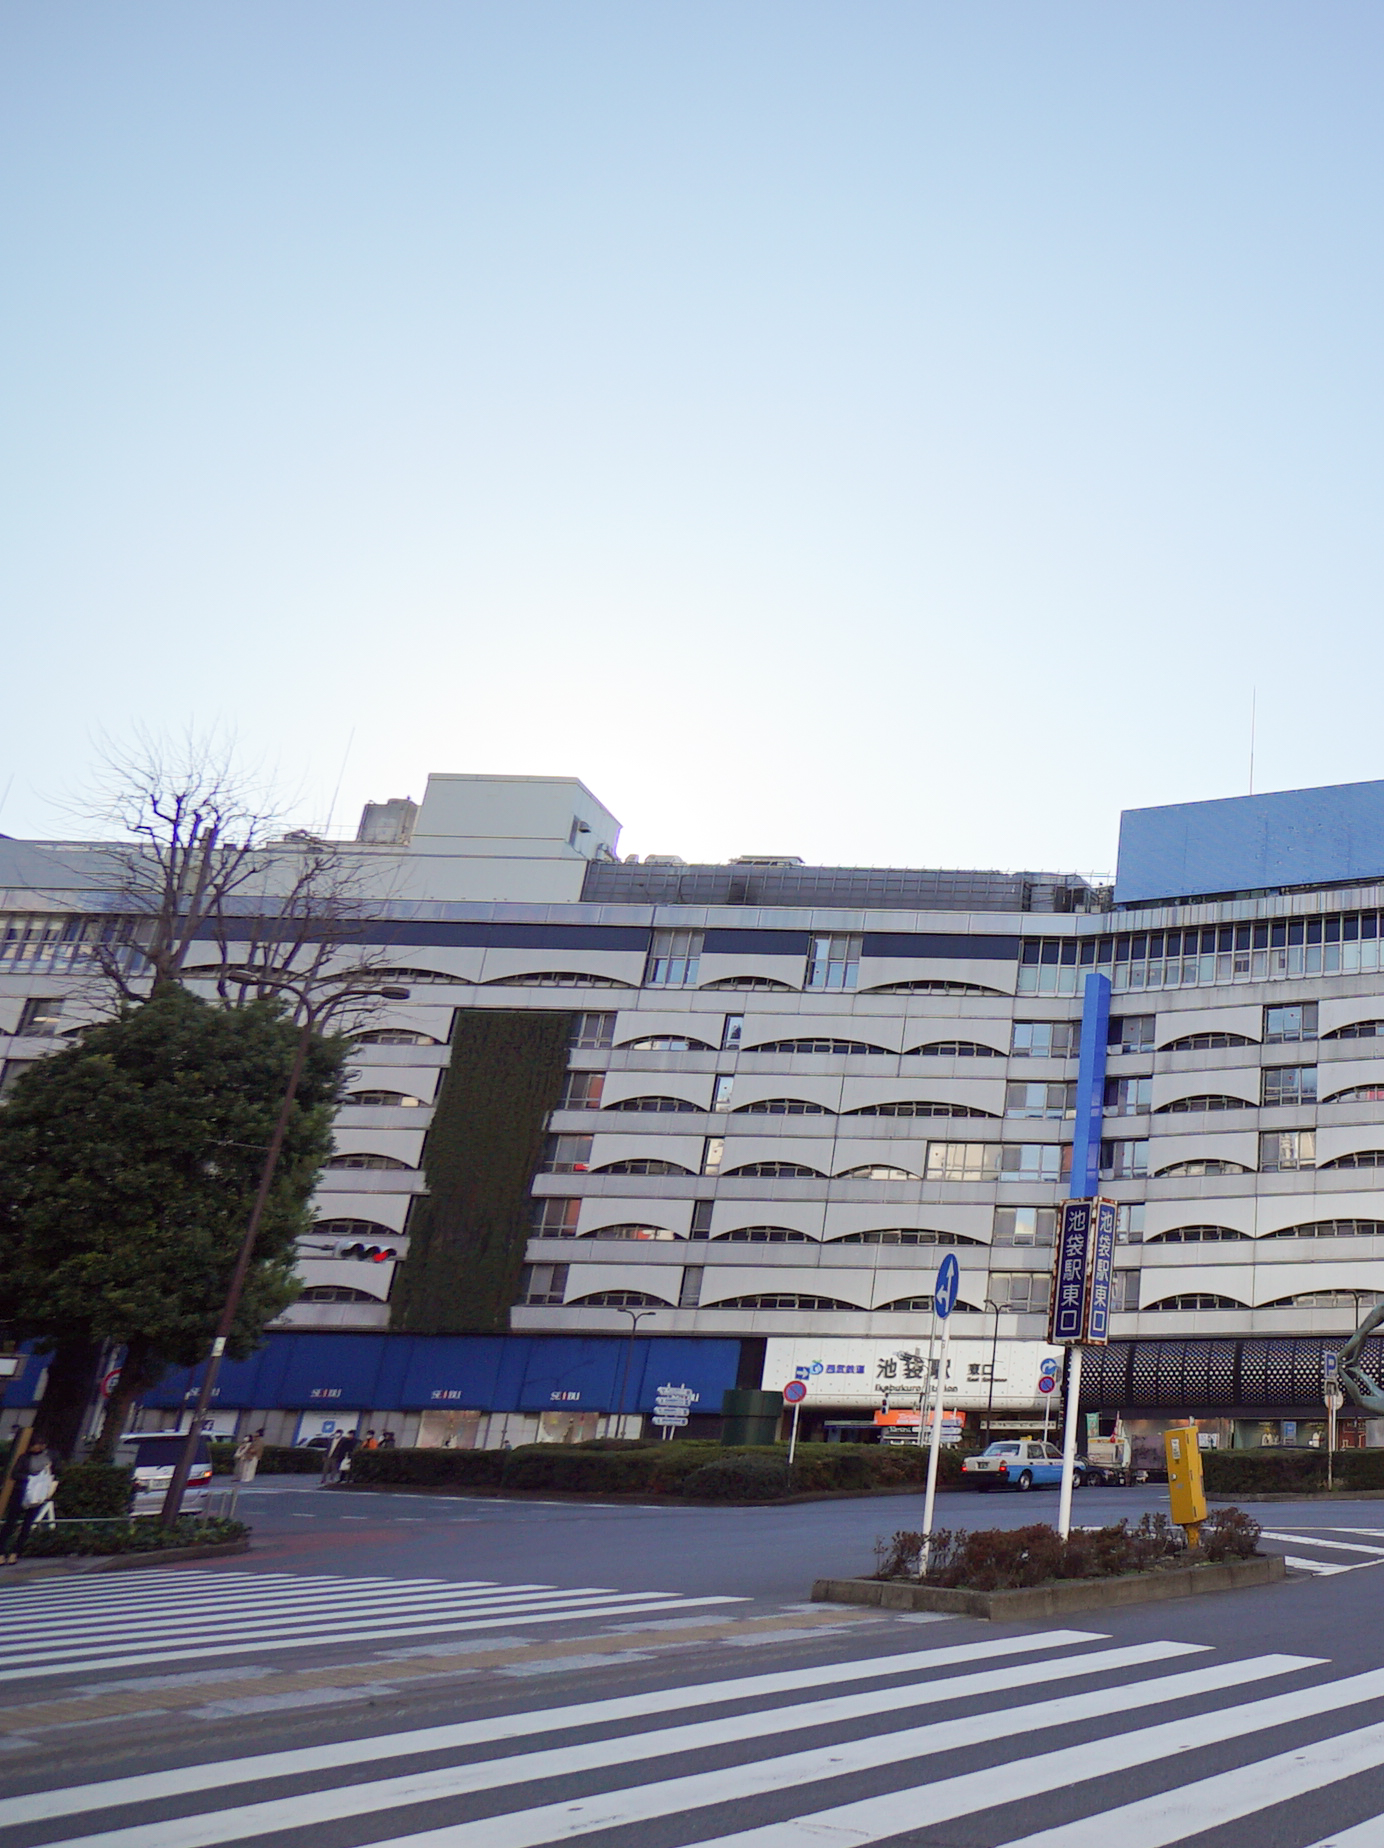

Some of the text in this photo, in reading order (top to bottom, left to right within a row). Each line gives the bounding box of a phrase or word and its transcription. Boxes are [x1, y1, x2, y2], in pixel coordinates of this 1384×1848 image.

[1060, 1209, 1087, 1331] 池袋駅東口
[1092, 1209, 1114, 1332] 池袋駅東口
